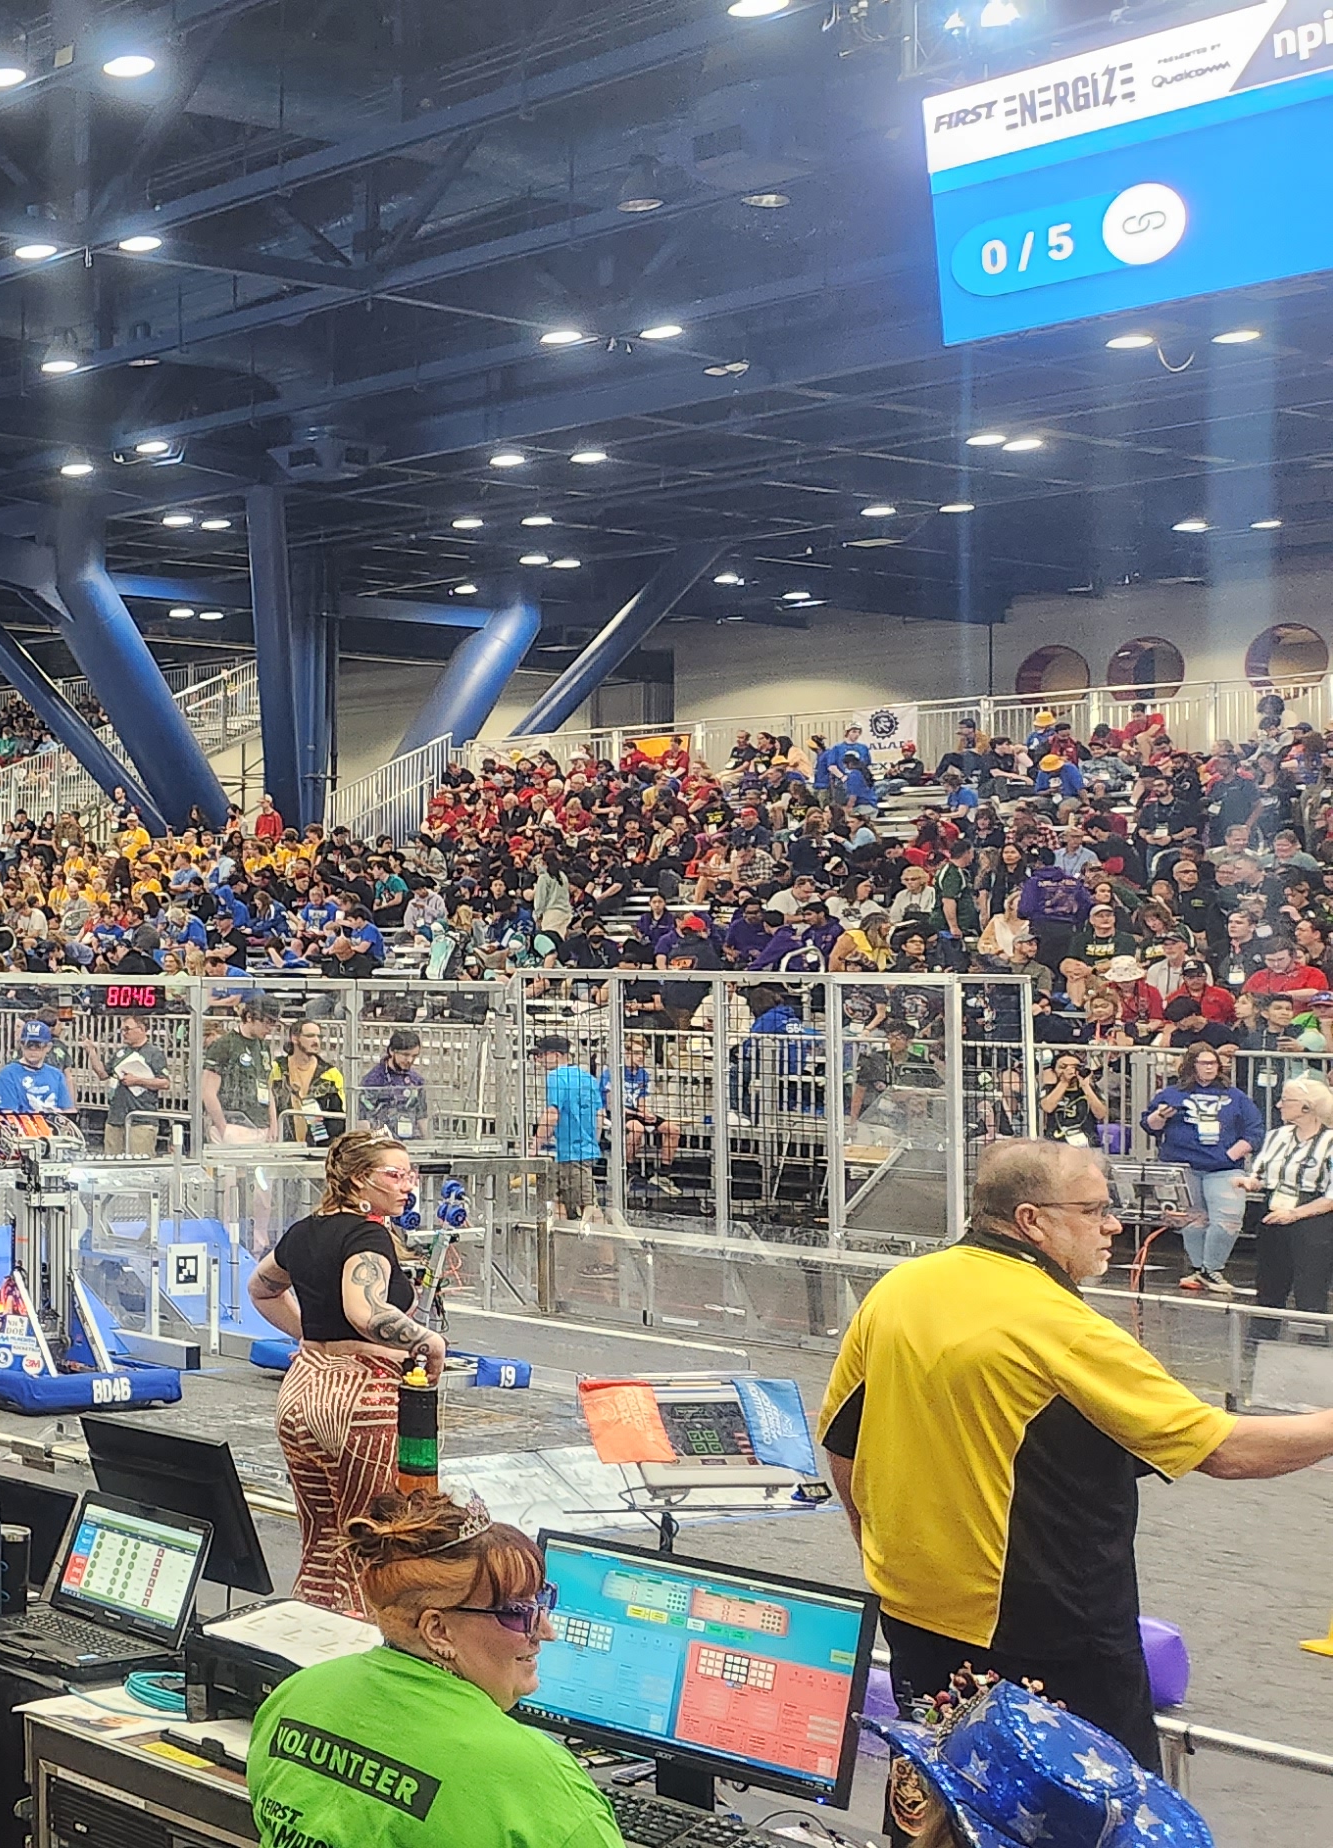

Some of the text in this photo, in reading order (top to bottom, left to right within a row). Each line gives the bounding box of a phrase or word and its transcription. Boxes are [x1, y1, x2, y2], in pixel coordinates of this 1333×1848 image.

[1151, 60, 1232, 89] Qualcomm
[933, 62, 1136, 134] FIRST ENERGIZE
[981, 239, 1008, 276] 0
[1047, 222, 1075, 262] 5
[106, 985, 156, 1008] 8046
[24, 1358, 41, 1369] 3M
[499, 1365, 516, 1388] 19
[92, 1376, 131, 1404] 8046
[276, 1724, 421, 1808] VOLUNTEER
[264, 1797, 304, 1825] FIRST
